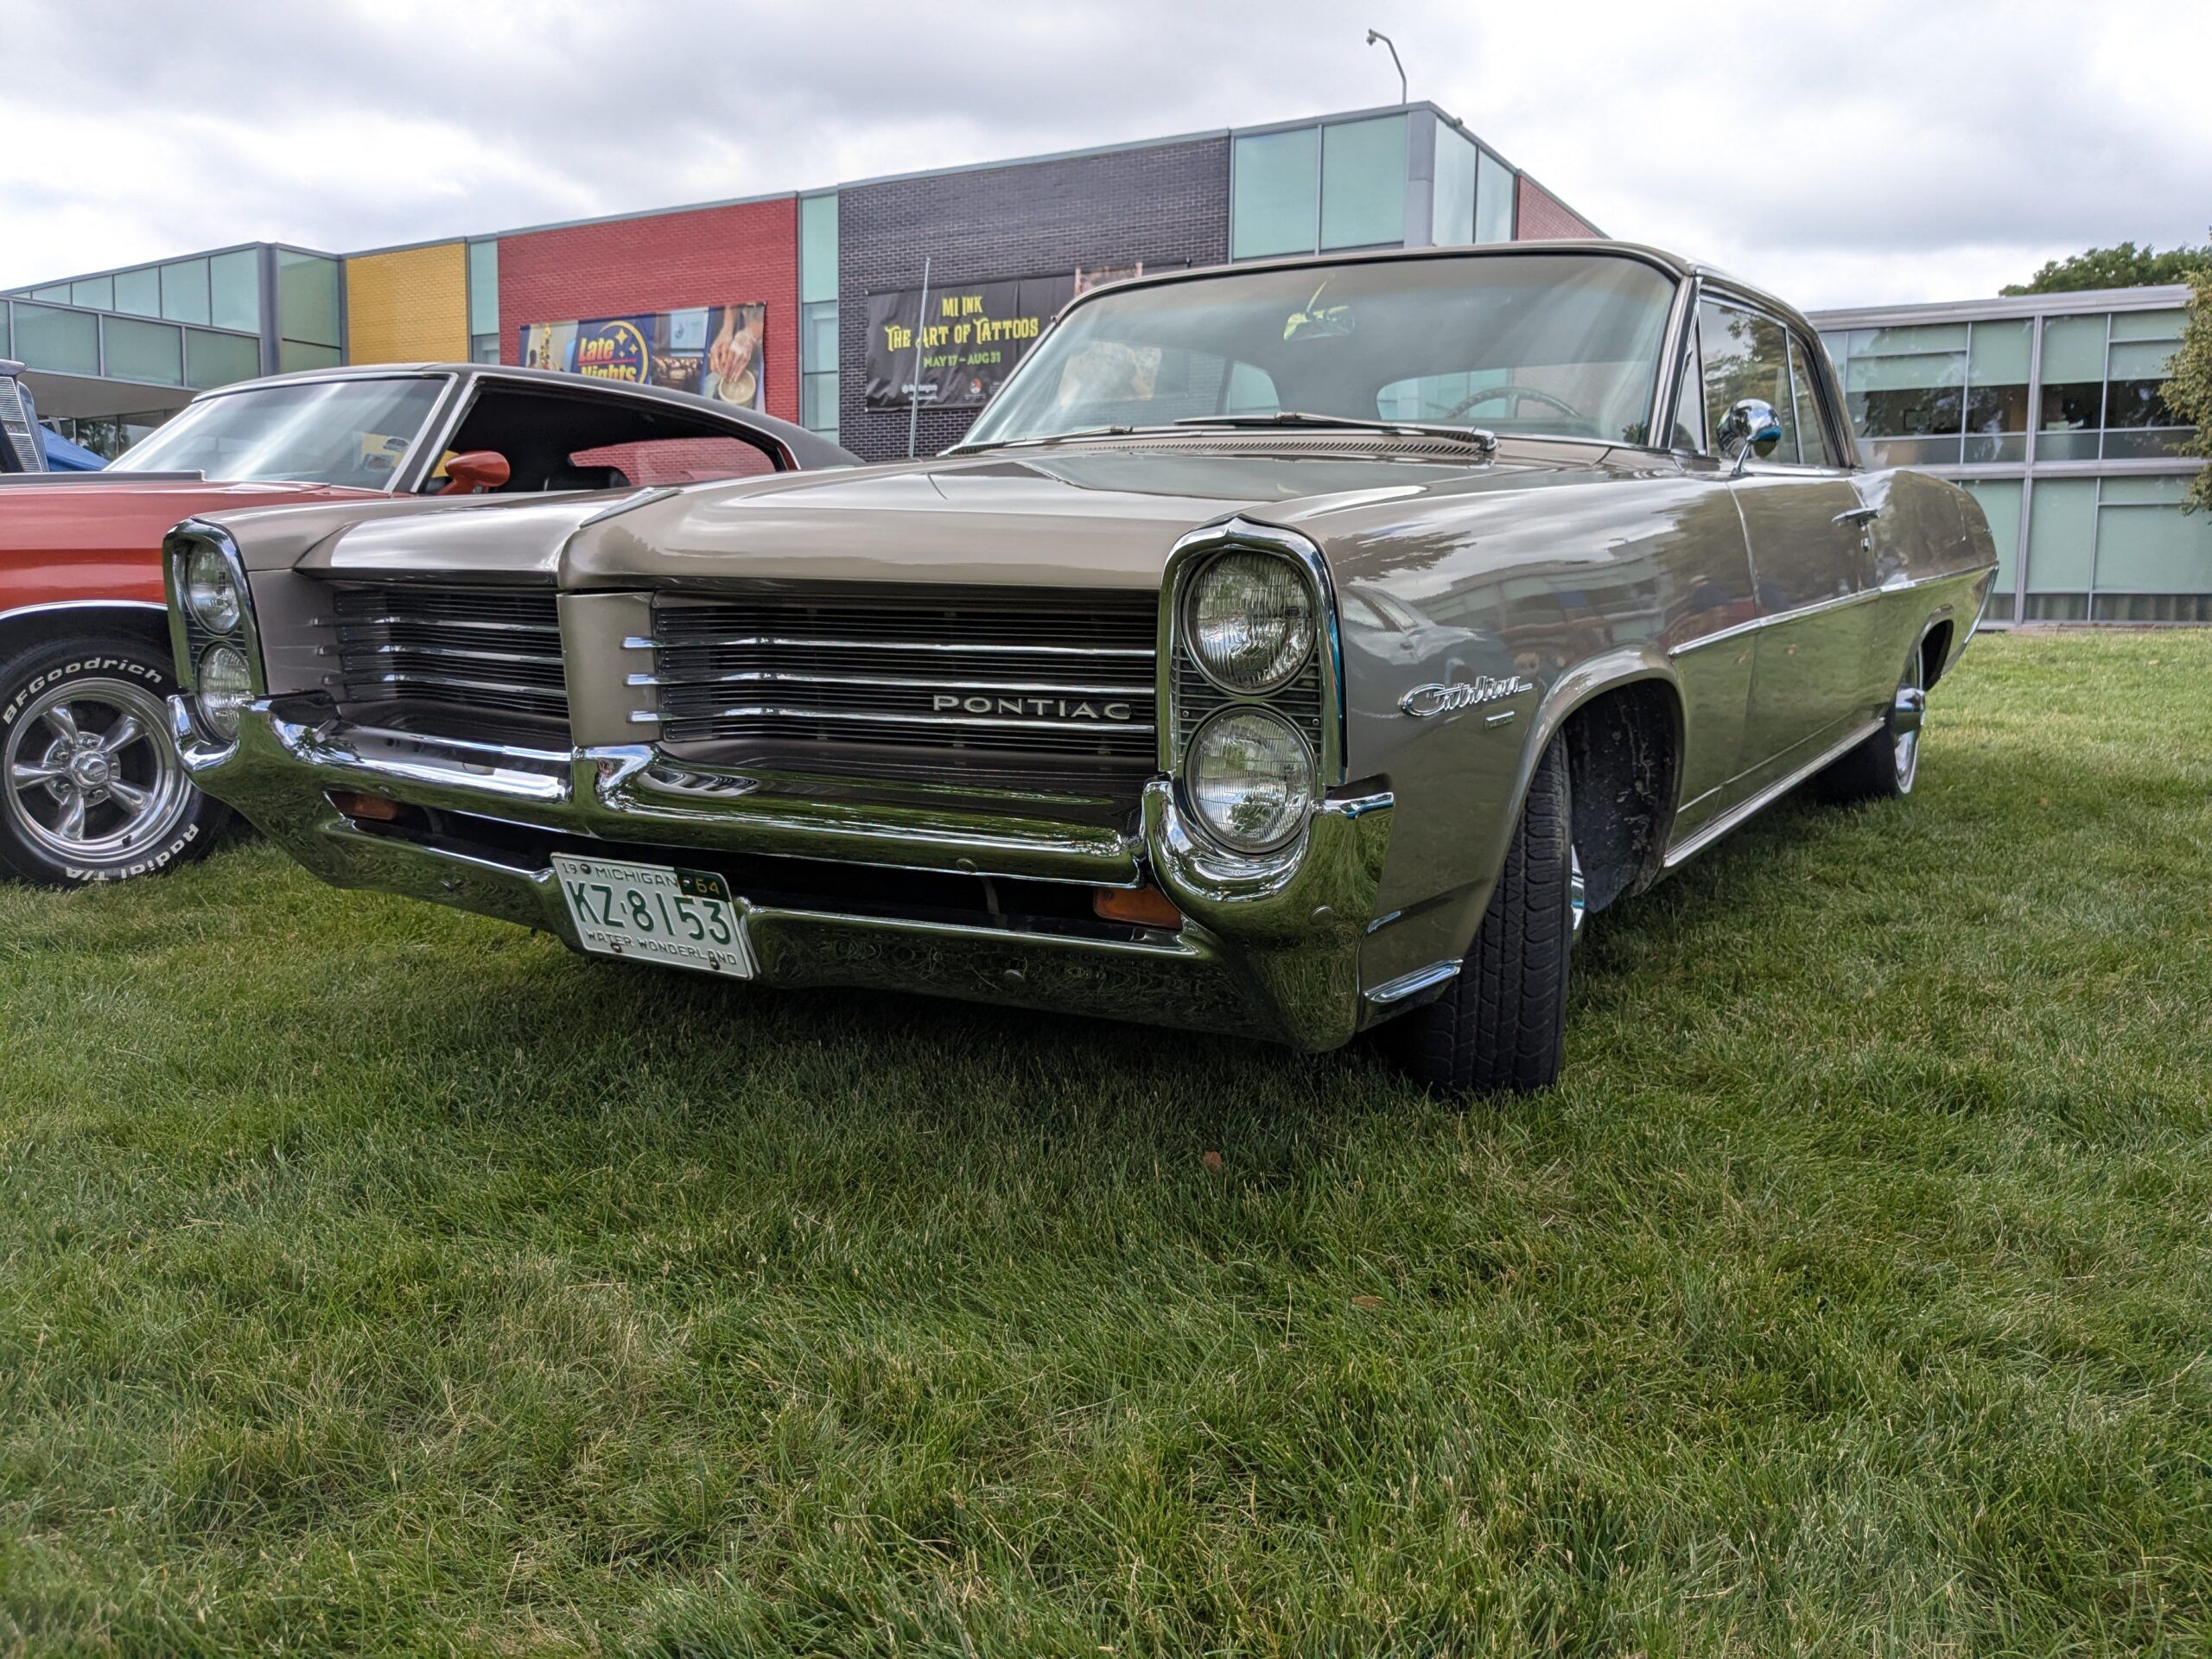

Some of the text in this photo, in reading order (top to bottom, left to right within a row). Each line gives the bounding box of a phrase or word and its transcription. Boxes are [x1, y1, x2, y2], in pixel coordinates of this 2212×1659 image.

[942, 296, 983, 317] MI INK
[579, 337, 615, 362] Late
[884, 317, 1039, 353] THE ART OF TATTOOS
[923, 356, 947, 368] MAY
[948, 354, 957, 366] 17
[967, 352, 989, 365] AUG
[989, 351, 1001, 364] 31
[2, 657, 163, 725] BFGoodrich
[932, 694, 1131, 720] PONTIAC
[66, 823, 200, 881] Radial T/A
[562, 862, 721, 895] 19 MICHIGAN 64
[585, 928, 738, 966] WATER WONDERLAND
